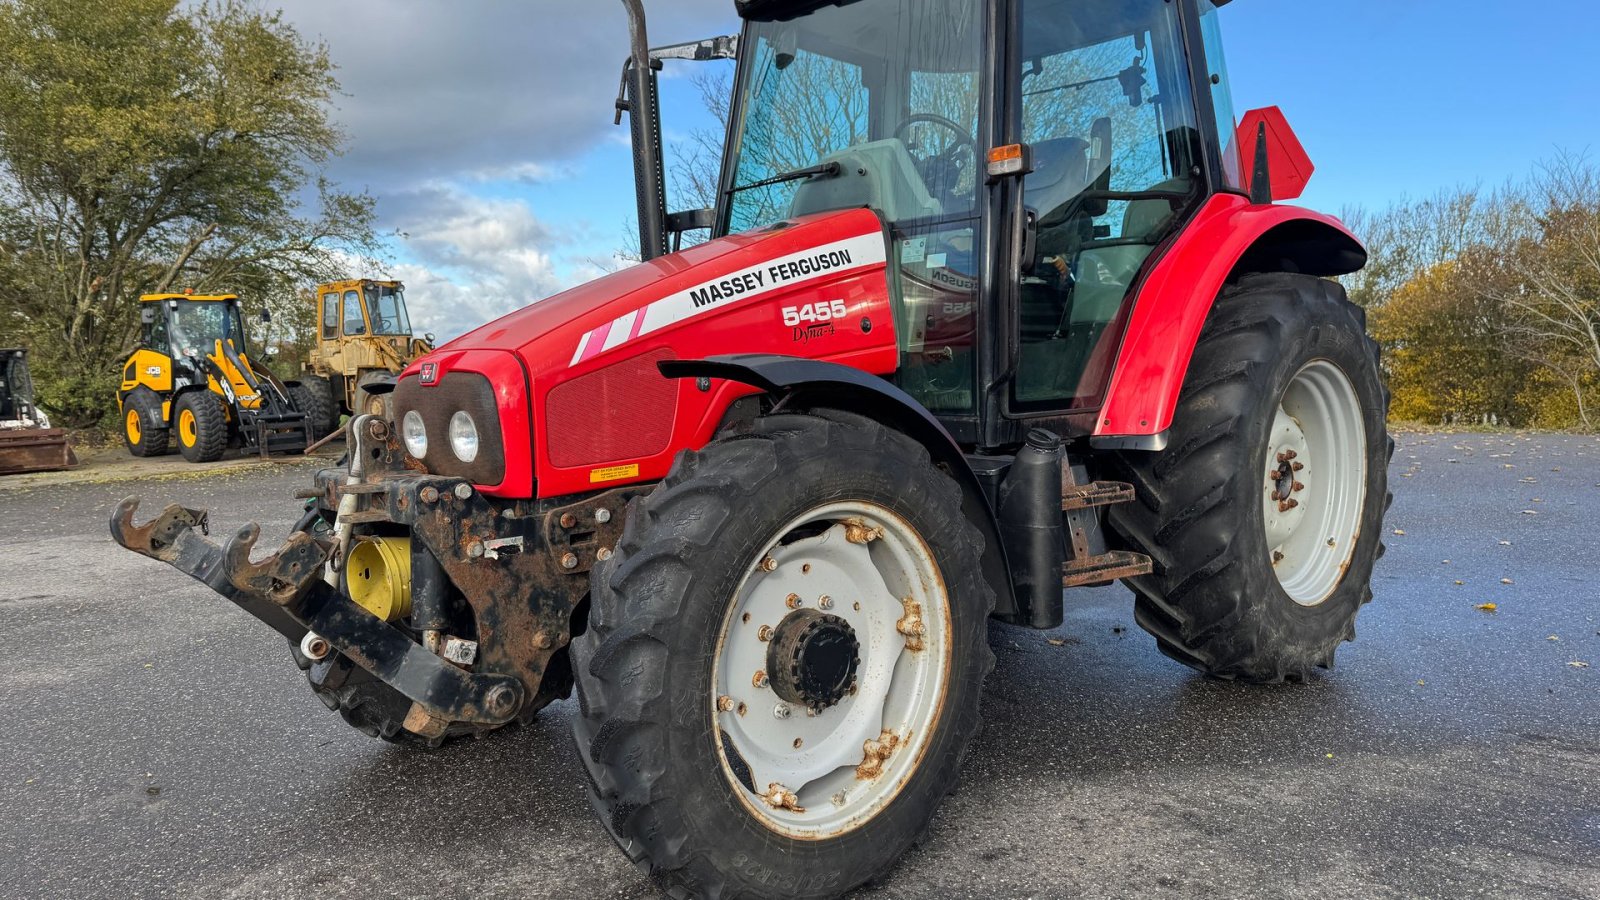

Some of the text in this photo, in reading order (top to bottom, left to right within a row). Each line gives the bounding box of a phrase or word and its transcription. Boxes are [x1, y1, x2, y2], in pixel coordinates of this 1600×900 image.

[690, 249, 852, 307] MASSEY FERGUSON
[782, 299, 847, 327] 5455
[793, 322, 835, 344] Dyna-4
[145, 366, 161, 375] JCB
[220, 376, 235, 404] JCB
